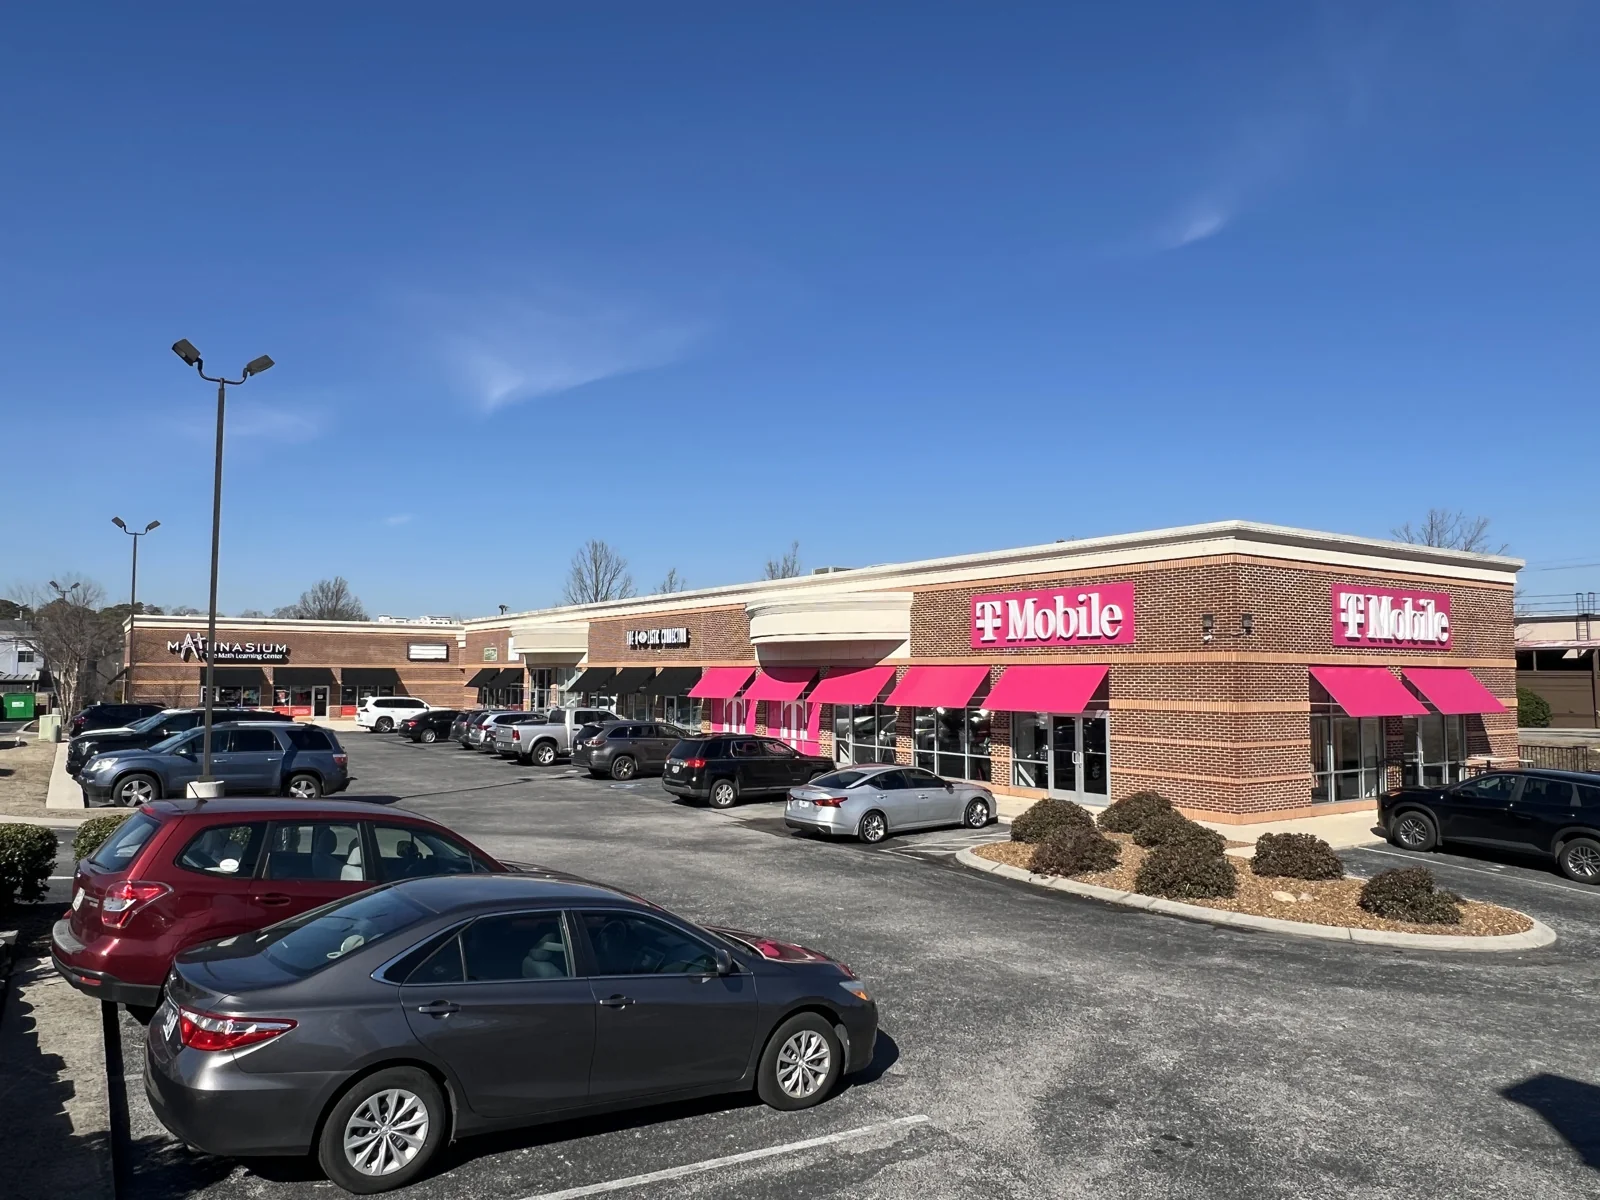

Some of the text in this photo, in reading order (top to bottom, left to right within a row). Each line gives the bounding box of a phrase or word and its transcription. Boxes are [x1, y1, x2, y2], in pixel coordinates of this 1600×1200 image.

[1005, 592, 1124, 640] Mobile
[1365, 594, 1449, 642] Mobile
[235, 652, 262, 660] Learning
